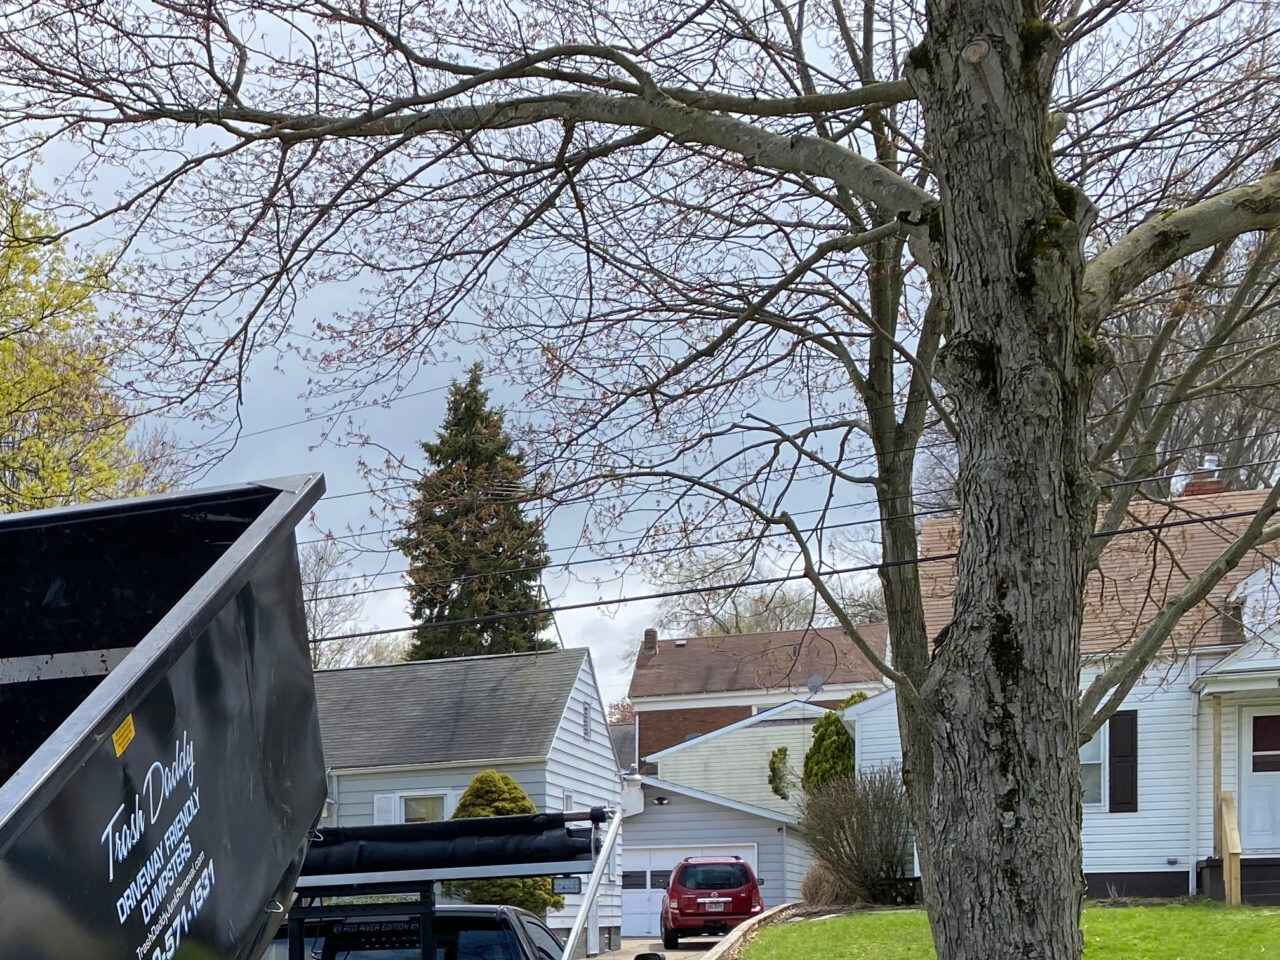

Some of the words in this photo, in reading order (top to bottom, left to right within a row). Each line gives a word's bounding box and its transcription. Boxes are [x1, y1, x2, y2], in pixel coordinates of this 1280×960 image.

[101, 793, 145, 882] Trash
[143, 730, 196, 824] Daddy
[116, 840, 165, 924] DRIVEWAY
[164, 786, 200, 856] FRIENDLY
[141, 835, 192, 925] DUMPSTERS
